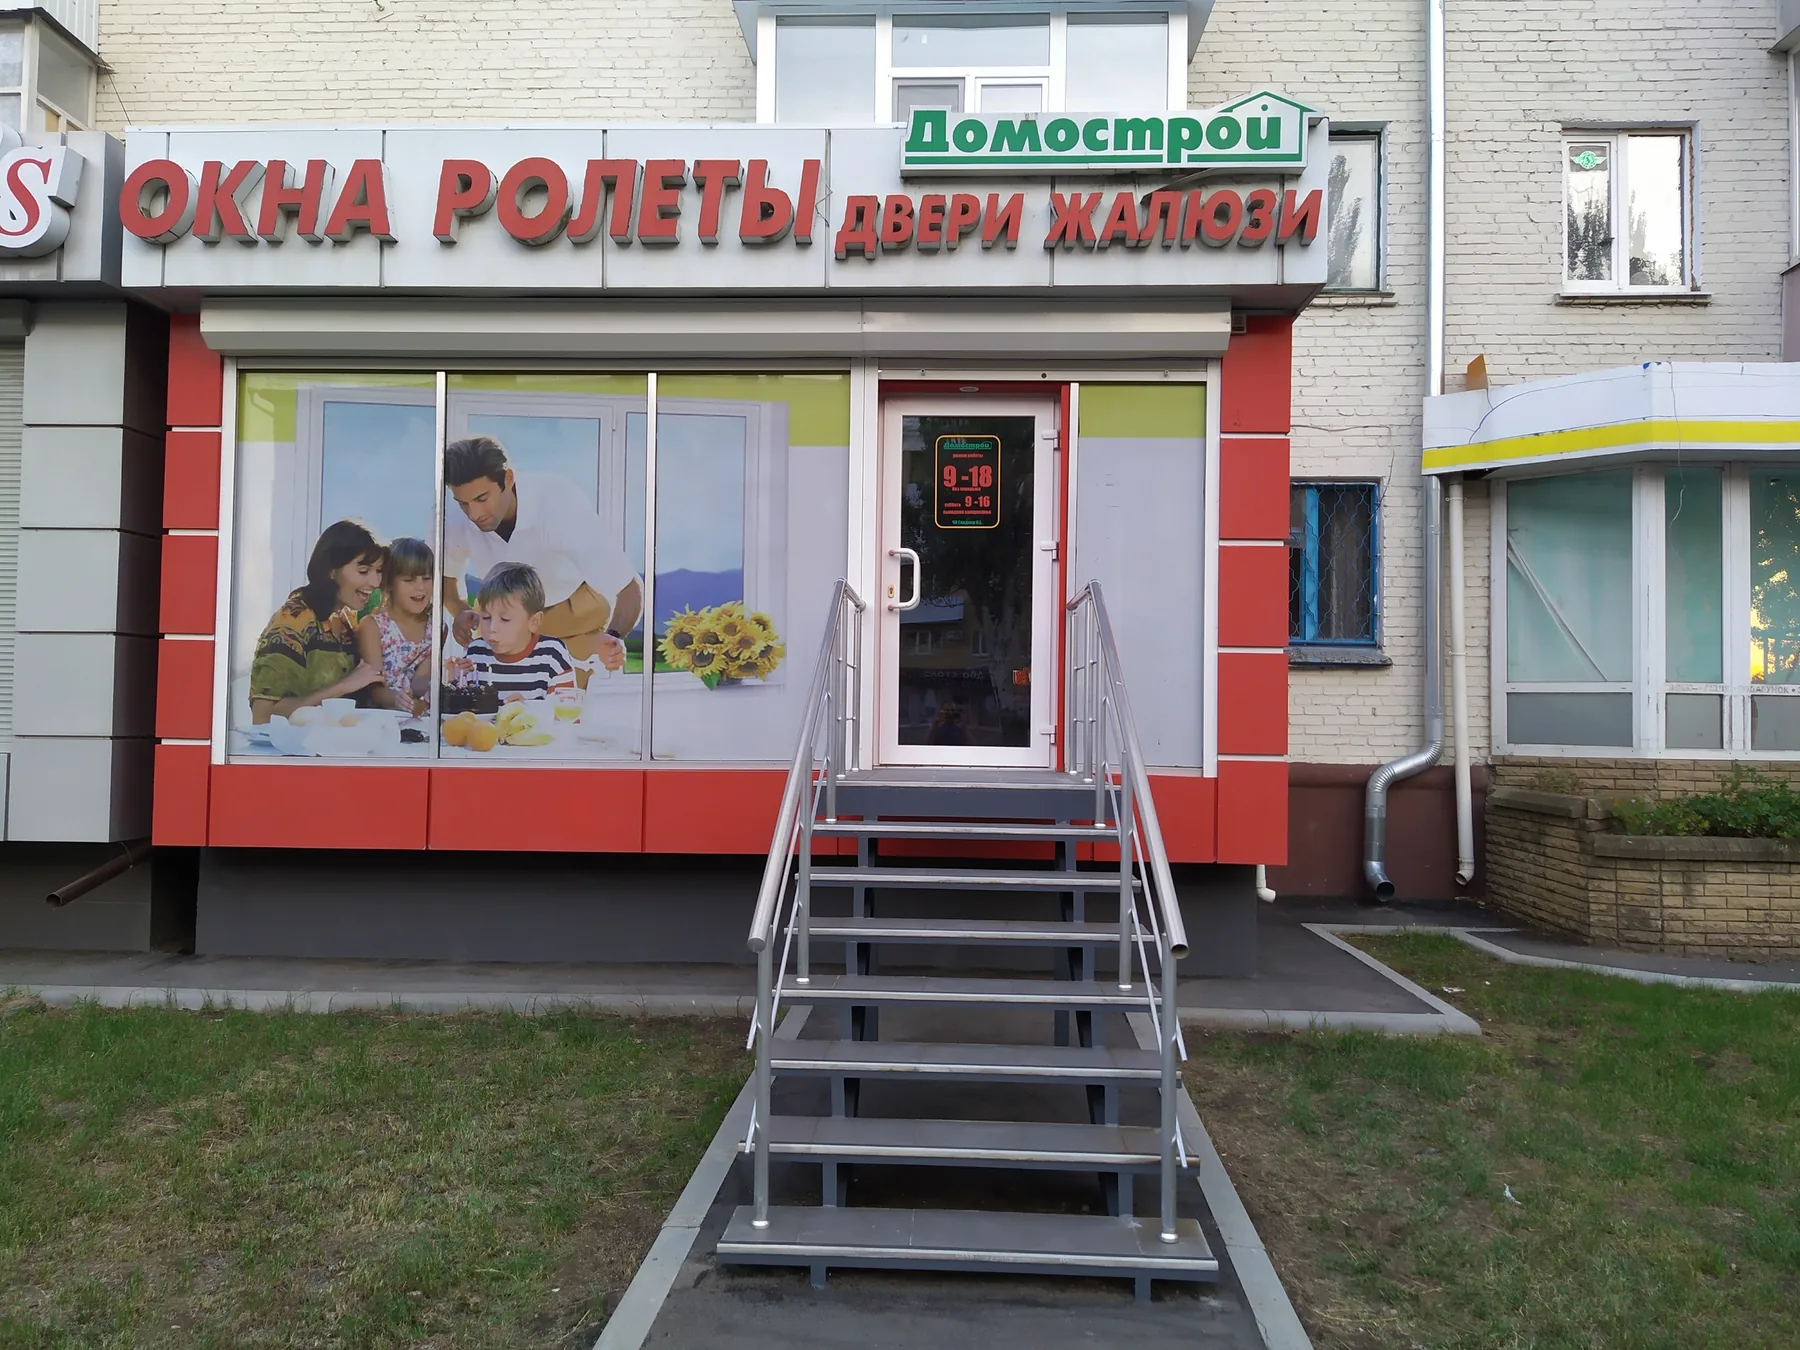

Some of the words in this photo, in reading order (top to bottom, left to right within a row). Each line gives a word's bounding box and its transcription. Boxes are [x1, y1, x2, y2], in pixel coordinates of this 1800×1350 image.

[905, 104, 1282, 163] Домострой
[119, 158, 395, 243] ОКНА
[433, 157, 821, 244] РОЛЕТЫ
[834, 193, 1024, 257] ДВЕРИ
[1044, 188, 1323, 249] ЖАЛЮЗИ
[943, 465, 957, 487] 9
[965, 495, 972, 507] 9
